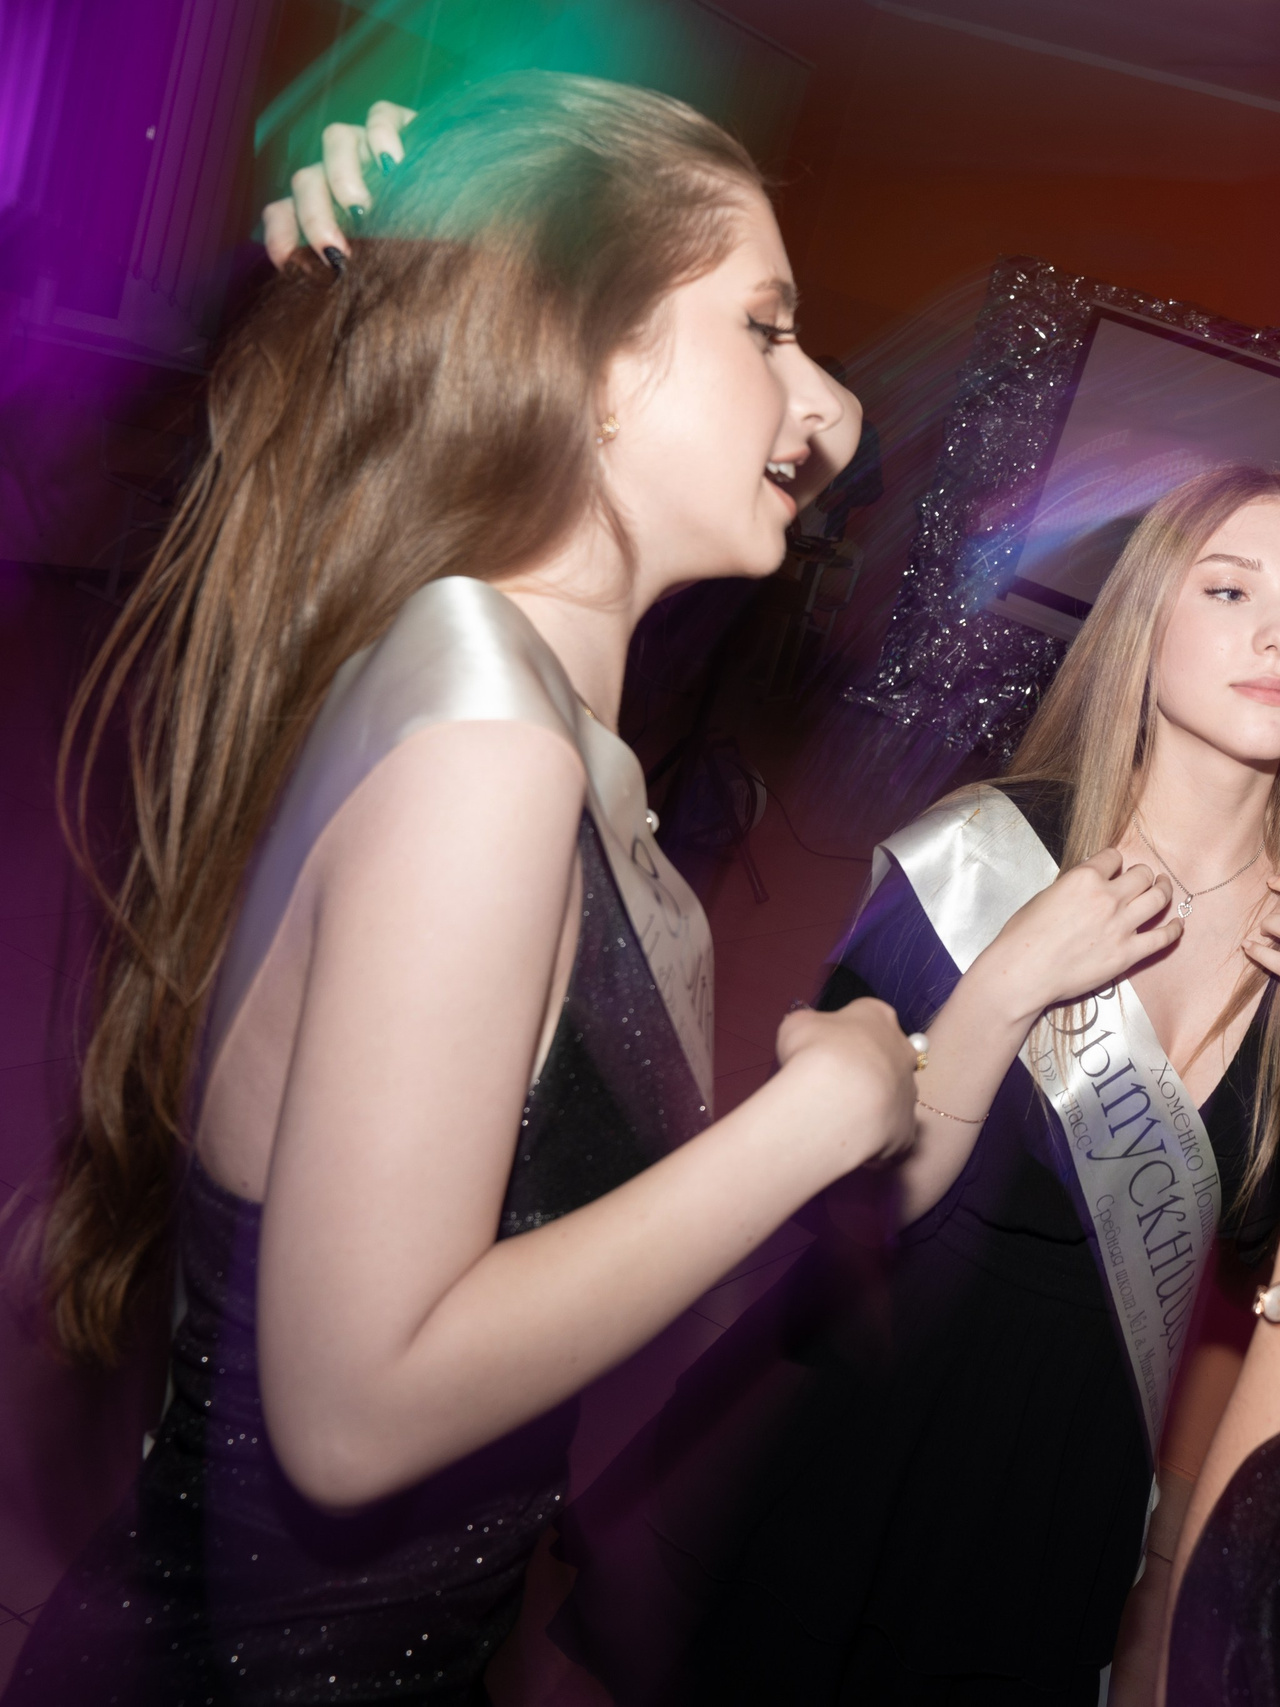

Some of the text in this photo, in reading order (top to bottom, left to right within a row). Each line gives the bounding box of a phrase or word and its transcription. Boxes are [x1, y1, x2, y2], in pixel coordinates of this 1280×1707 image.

[1056, 1088, 1092, 1151] класс
[1151, 1061, 1204, 1171] Хоменко
[1094, 1194, 1123, 1267] Средняя
[1115, 1269, 1136, 1311] школа
